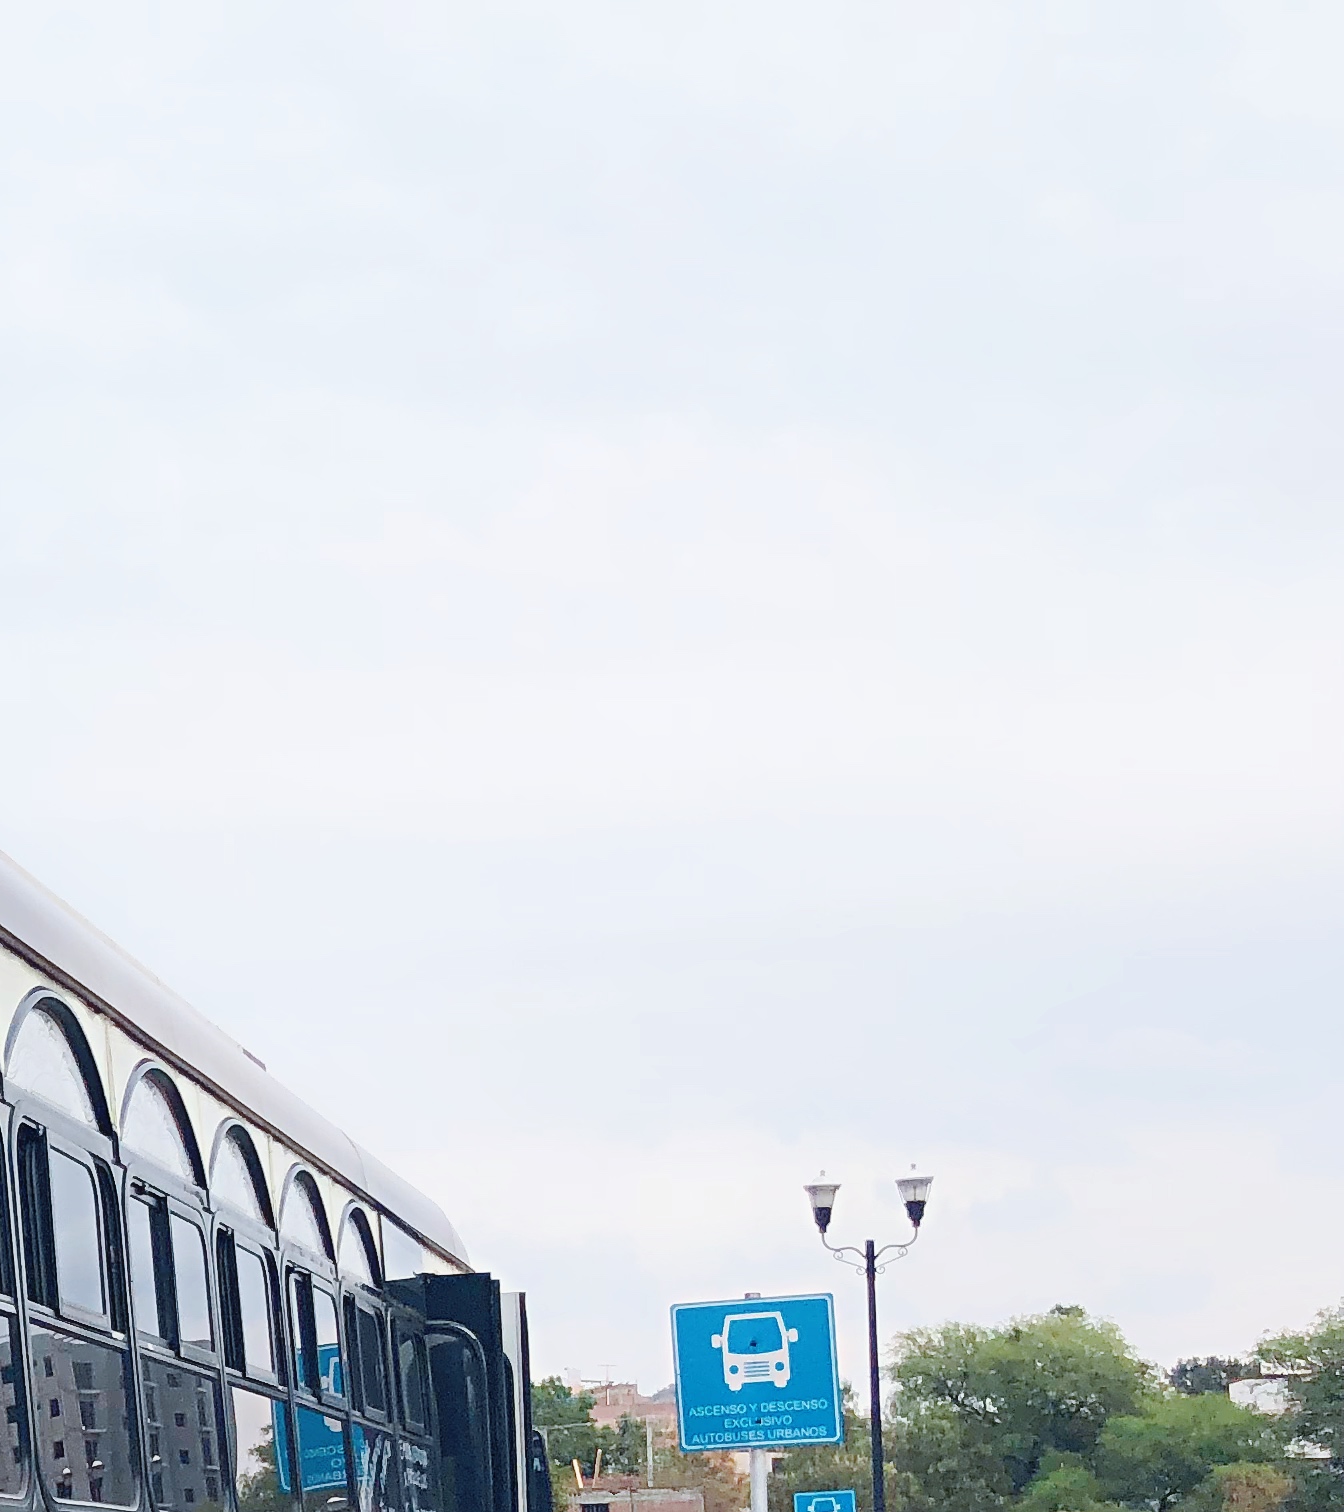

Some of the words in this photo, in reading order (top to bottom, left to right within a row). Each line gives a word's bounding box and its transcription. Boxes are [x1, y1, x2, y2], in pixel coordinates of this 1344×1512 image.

[689, 1404, 747, 1417] ASCENSO
[749, 1403, 758, 1412] Y
[760, 1399, 828, 1413] DESCENSO
[724, 1415, 792, 1429] EXCLUSIVO
[692, 1430, 765, 1444] AUTOBUSES
[767, 1426, 828, 1440] URBANOS
